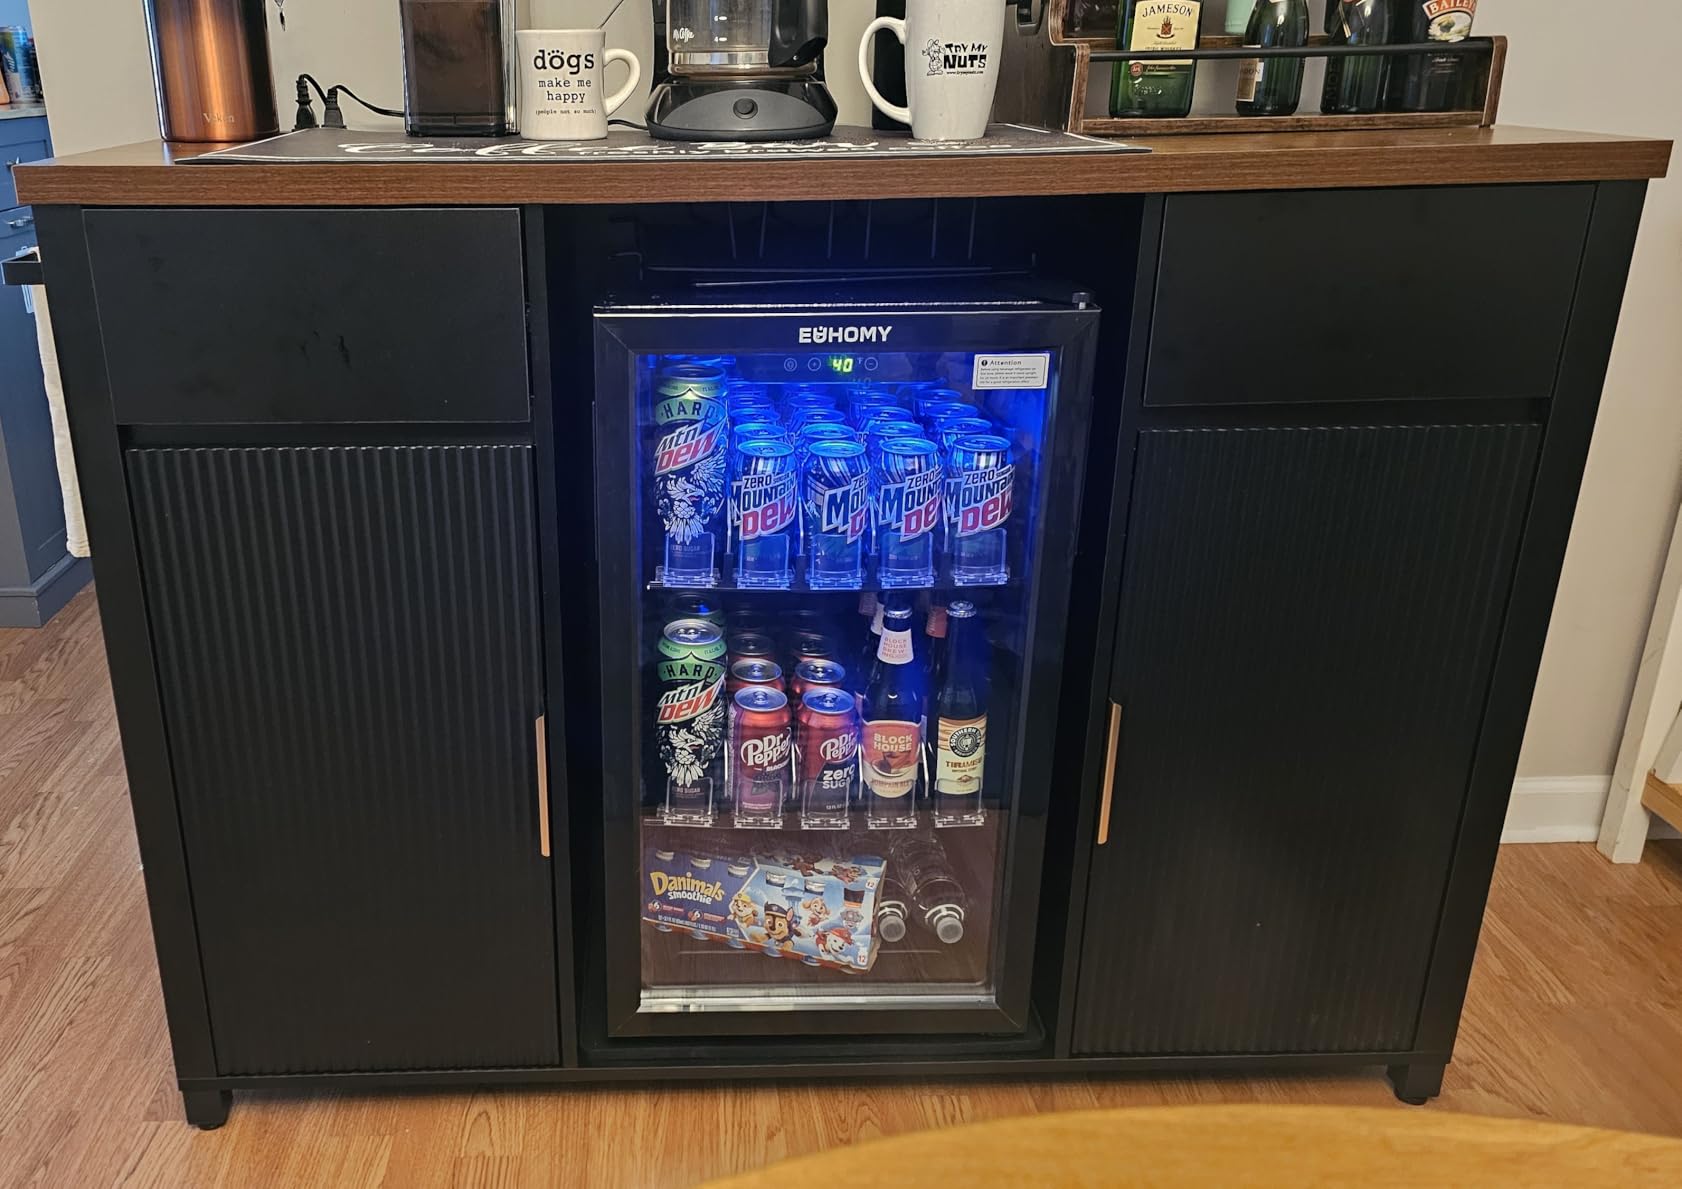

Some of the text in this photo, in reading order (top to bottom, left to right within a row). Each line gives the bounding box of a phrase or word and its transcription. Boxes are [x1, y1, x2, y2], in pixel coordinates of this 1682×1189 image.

[1142, 3, 1193, 17] JAMESON
[944, 43, 988, 53] TRY MY
[943, 54, 987, 69] NUTS
[538, 77, 592, 88] make me
[547, 91, 586, 104] happy
[832, 358, 854, 373] 40
[664, 401, 716, 420] HARD
[665, 663, 716, 679] HARD
[762, 733, 784, 752] Dr
[838, 732, 854, 748] Dr
[873, 733, 913, 744] BLOCK
[741, 735, 791, 767] Pepper
[873, 741, 913, 753] HOUSE
[823, 764, 856, 781] zero
[650, 871, 725, 902] Danimals
[667, 890, 713, 905] smoothie
